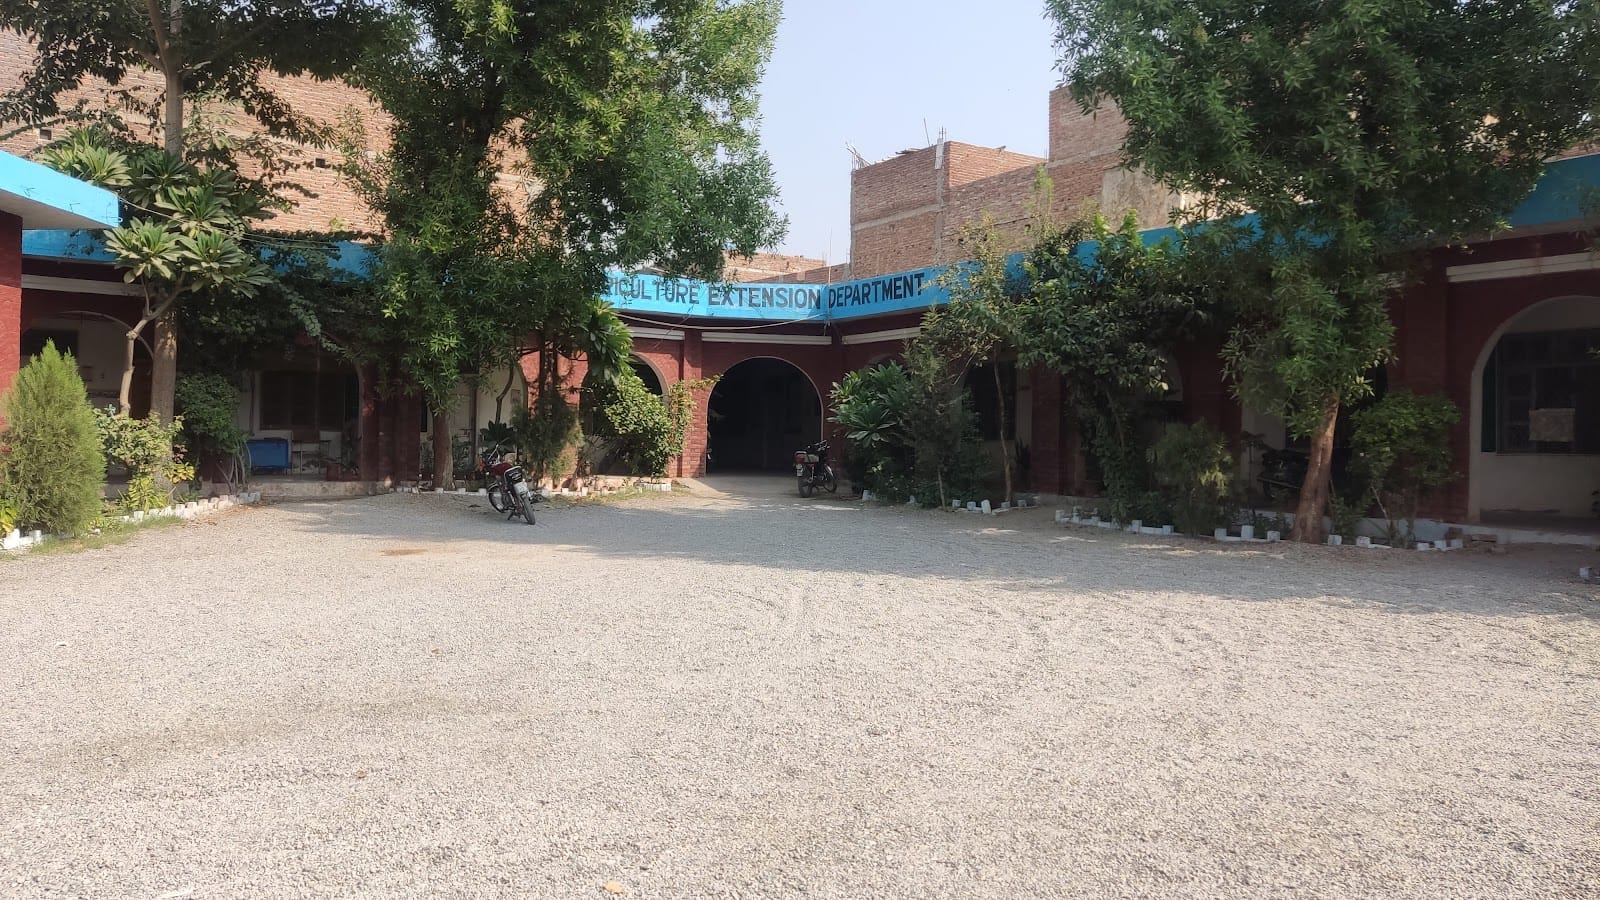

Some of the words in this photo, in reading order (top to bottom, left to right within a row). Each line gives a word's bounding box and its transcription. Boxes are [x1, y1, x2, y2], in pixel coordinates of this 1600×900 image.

[606, 277, 700, 304] RICULTURE
[708, 285, 821, 310] EXTENSION
[828, 272, 925, 309] DEPARTMENT
